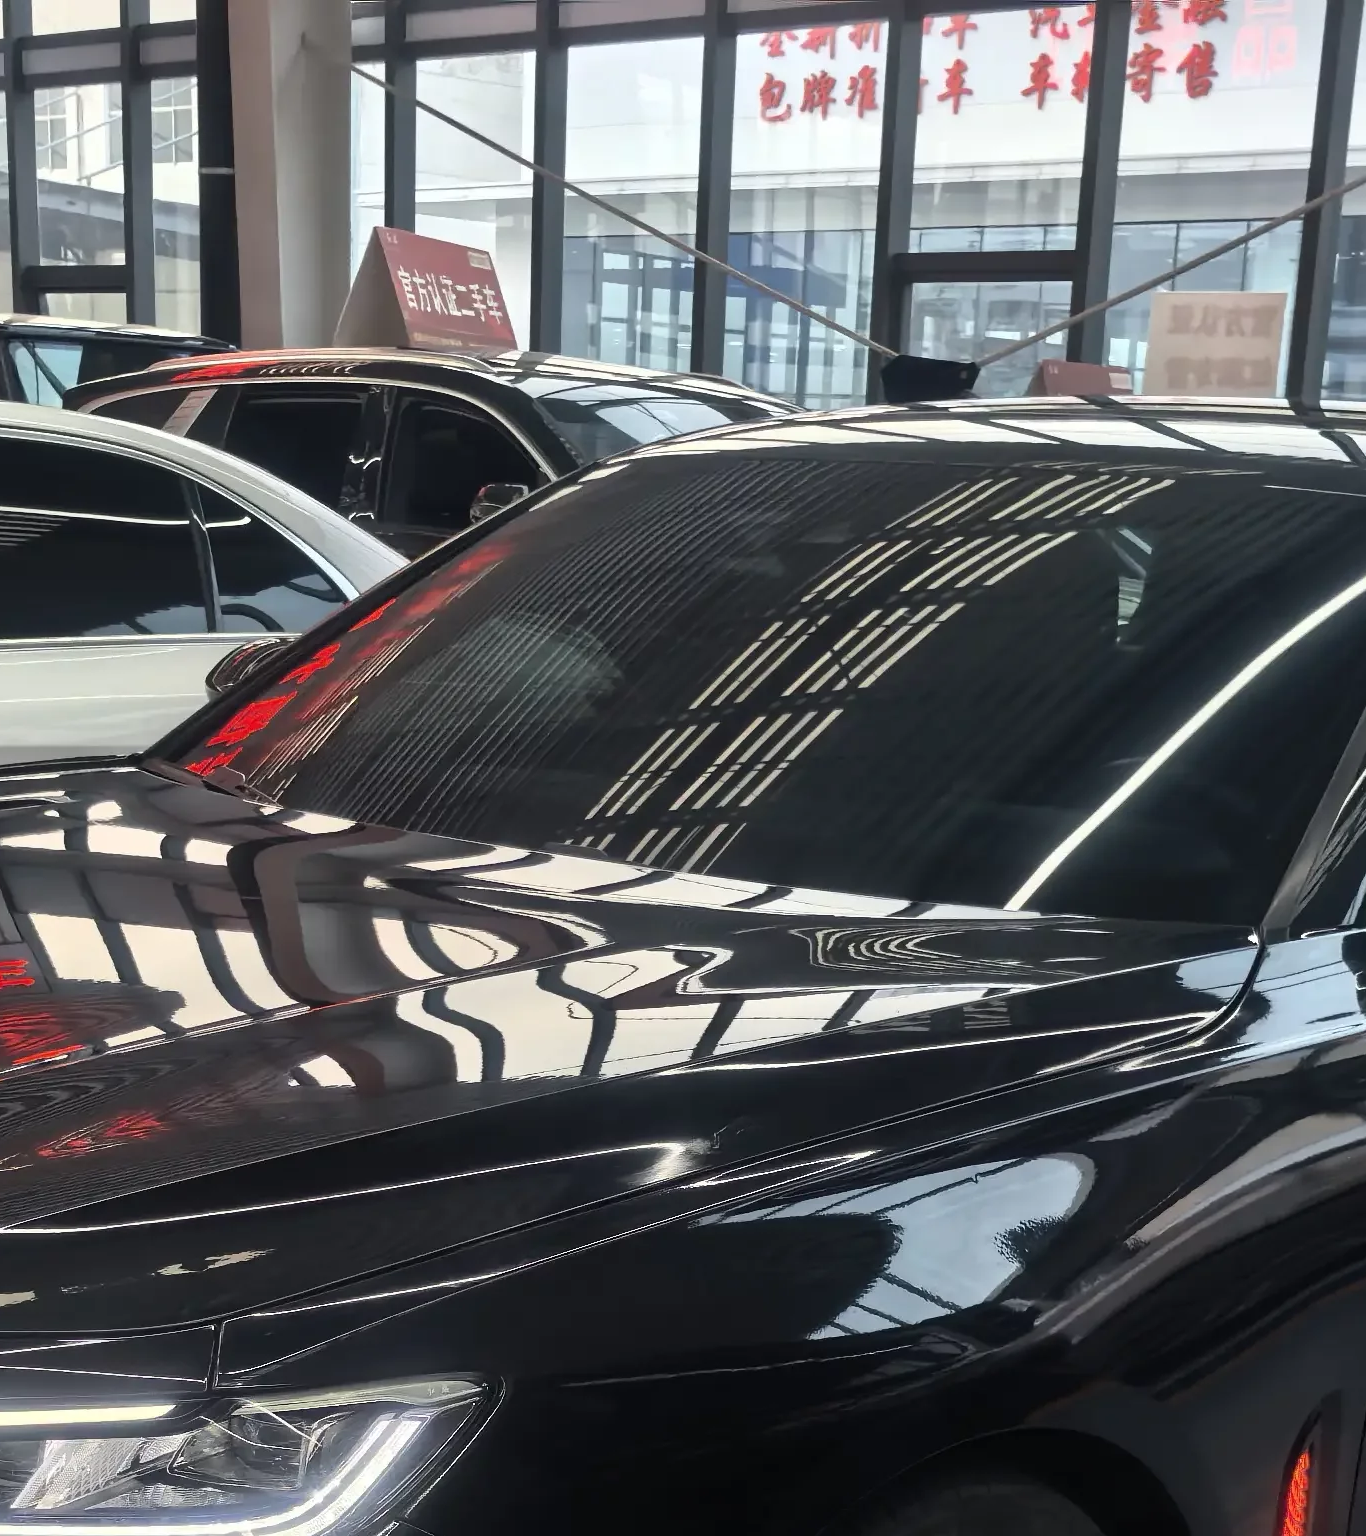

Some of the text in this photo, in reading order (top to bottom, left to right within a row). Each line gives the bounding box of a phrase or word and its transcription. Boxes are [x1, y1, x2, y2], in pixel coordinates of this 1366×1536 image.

[759, 59, 973, 122] 包牌准车
[397, 266, 503, 325] 官方认证二手车
